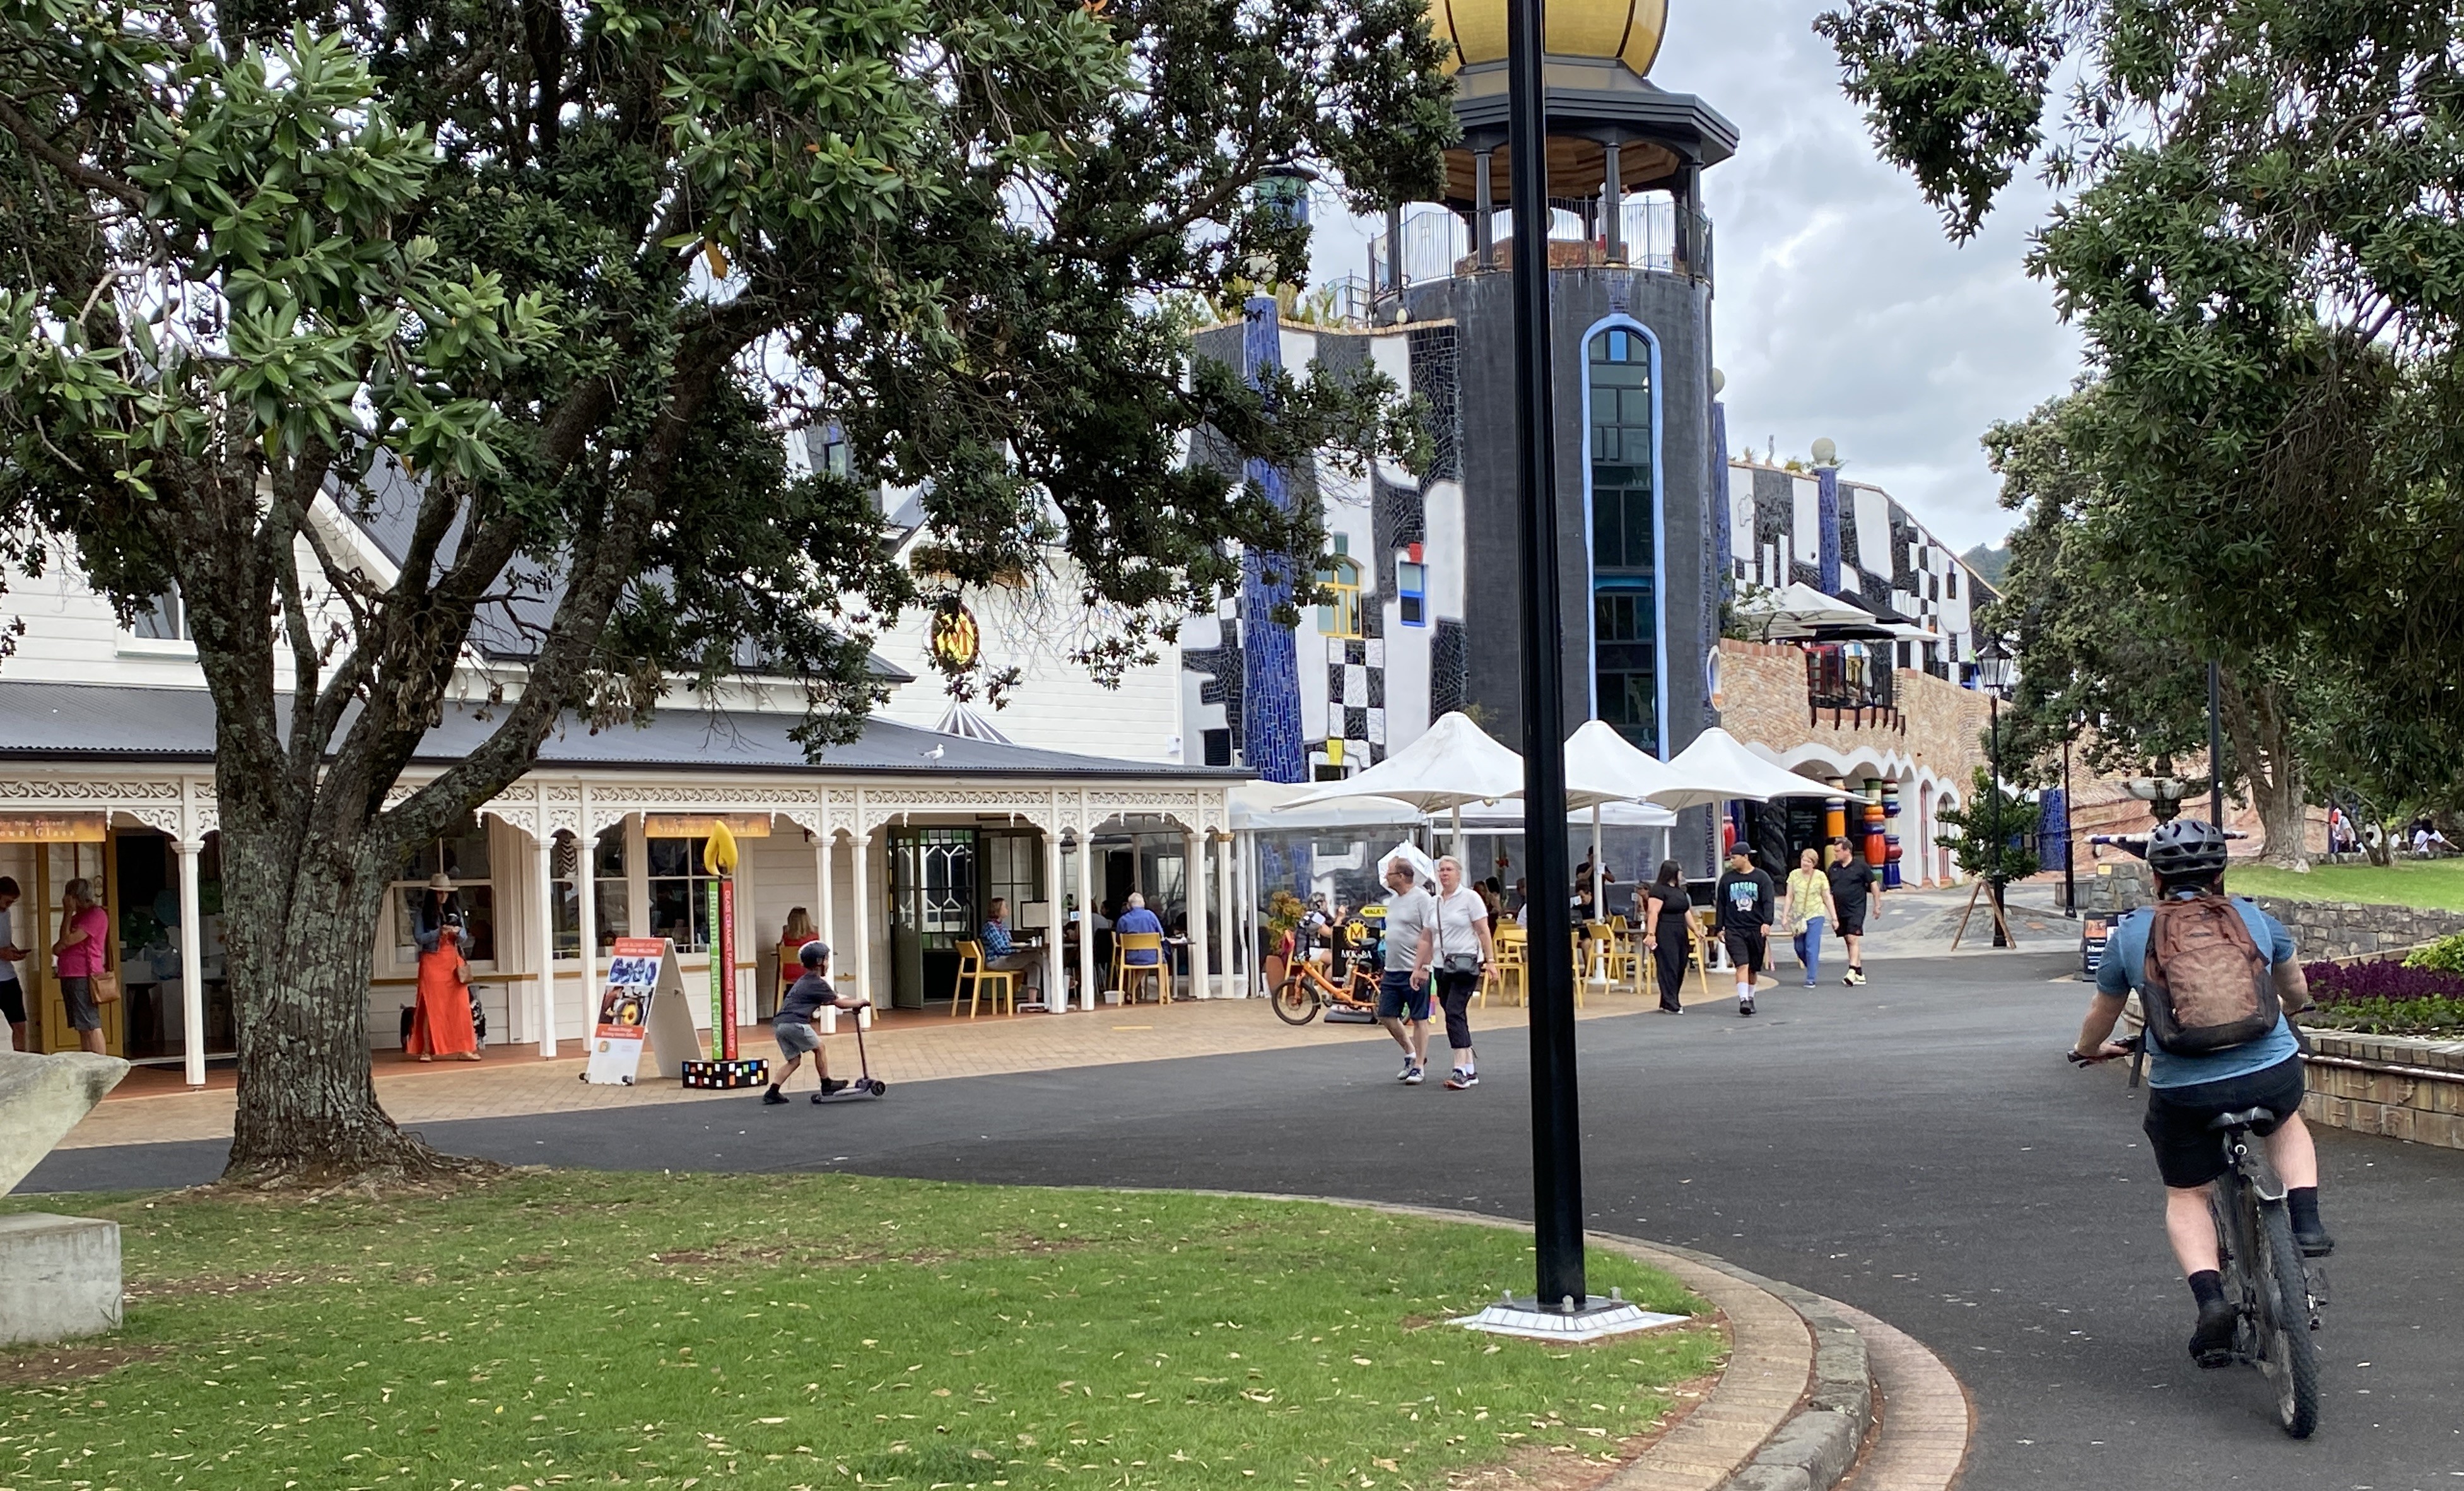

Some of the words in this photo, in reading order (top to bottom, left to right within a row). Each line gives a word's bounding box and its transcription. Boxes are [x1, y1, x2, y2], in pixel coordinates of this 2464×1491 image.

[35, 827, 75, 837] Glass
[708, 891, 720, 949] Burning
[1350, 926, 1363, 940] M
[711, 953, 720, 998] Issues
[712, 1001, 722, 1054] Gallery
